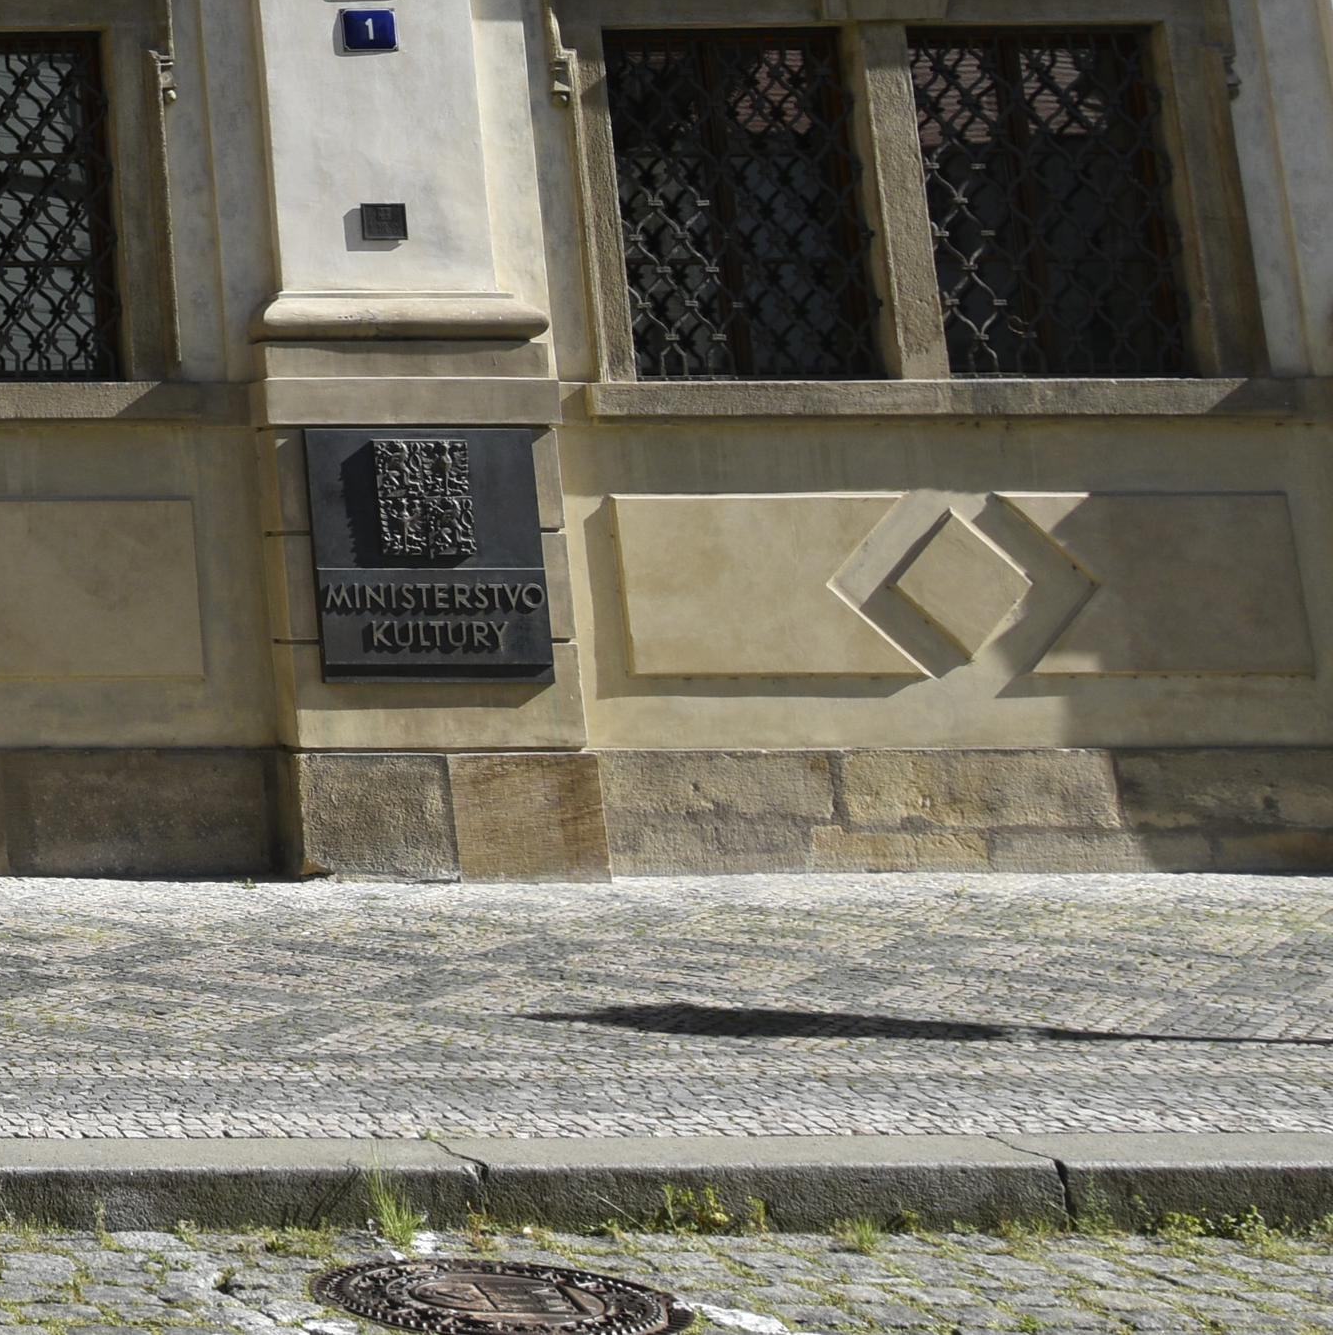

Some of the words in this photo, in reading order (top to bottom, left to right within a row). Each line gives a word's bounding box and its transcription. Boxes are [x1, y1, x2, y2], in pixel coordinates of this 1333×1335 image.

[365, 18, 375, 41] 1
[324, 582, 546, 609] MINISTERSTVO
[371, 620, 510, 648] KULTURY
